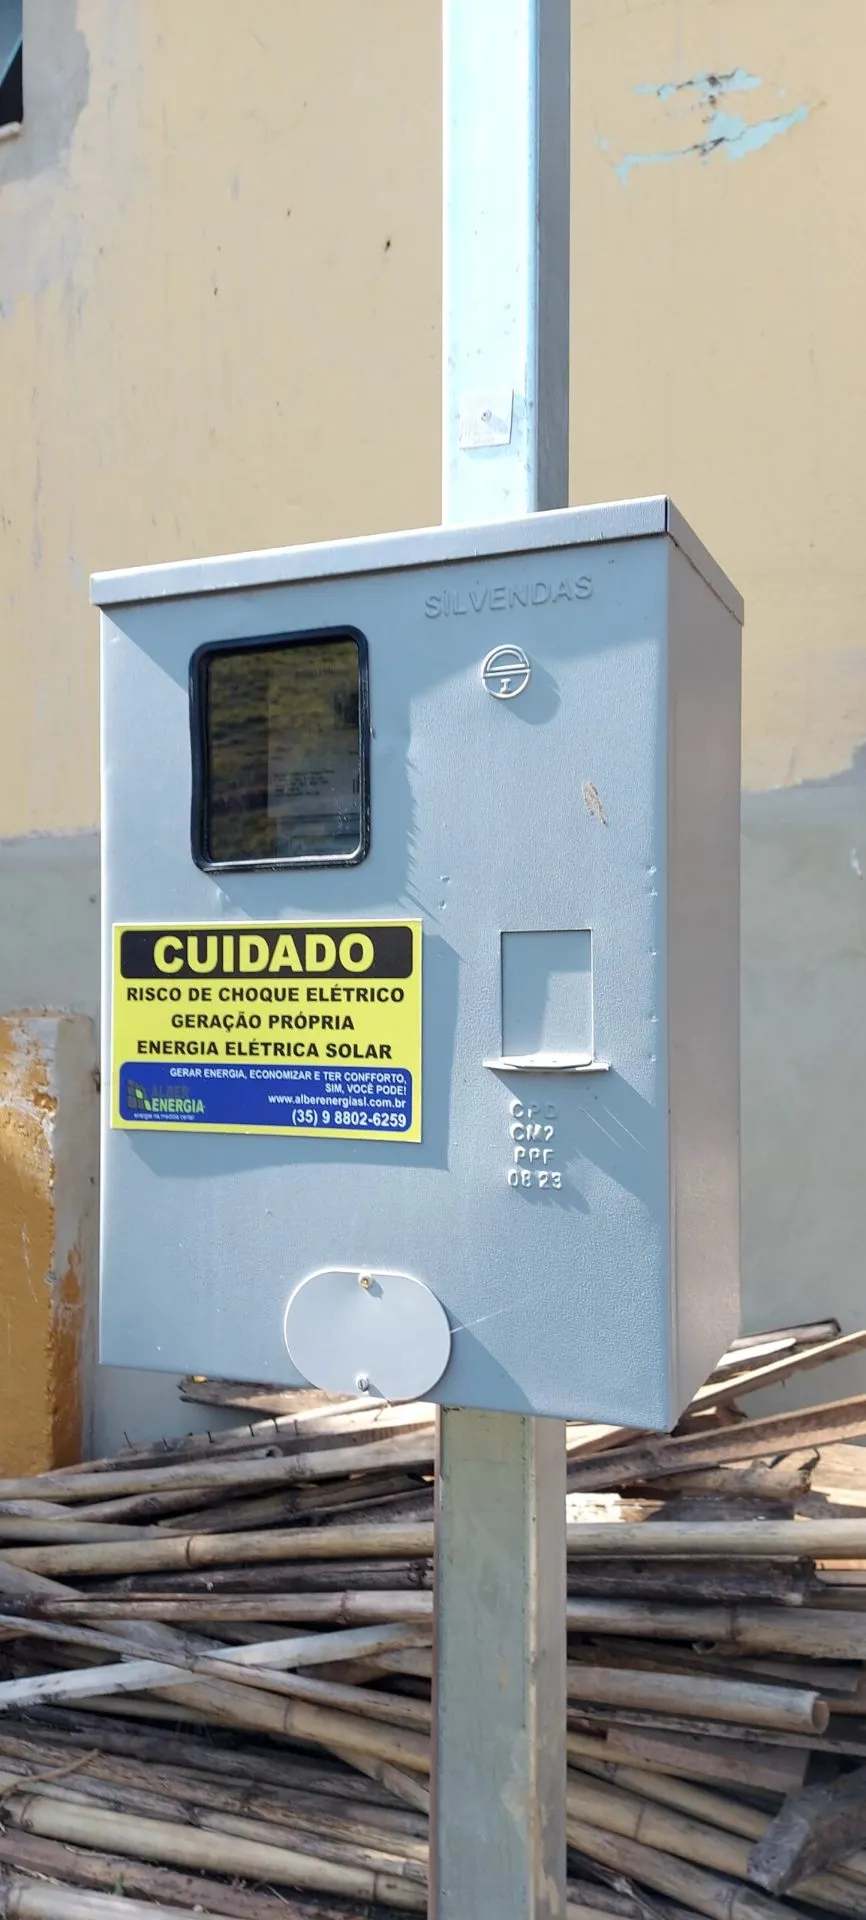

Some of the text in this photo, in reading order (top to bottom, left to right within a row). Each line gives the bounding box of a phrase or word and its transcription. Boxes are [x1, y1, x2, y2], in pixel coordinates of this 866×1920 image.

[424, 575, 593, 619] SILVENDAS
[153, 932, 374, 973] CUIDADO
[127, 985, 404, 1002] RISCO DE CHOQUE ELÉTRICO
[171, 1011, 354, 1032] GERAÇÃO PRÓPRIA
[138, 1039, 392, 1059] ENERGIA ELÉTRICA SOLAR
[170, 1068, 406, 1085] GERAR ENERGIA, ECONOMIZAR E TER CONFFORTO,
[325, 1082, 406, 1095] SIM, VOCÊ PODE!
[151, 1098, 204, 1113] ENERGIA
[268, 1094, 406, 1108] www.alberenergiasl.com.br
[292, 1109, 406, 1127] (35) 9 8802-6259
